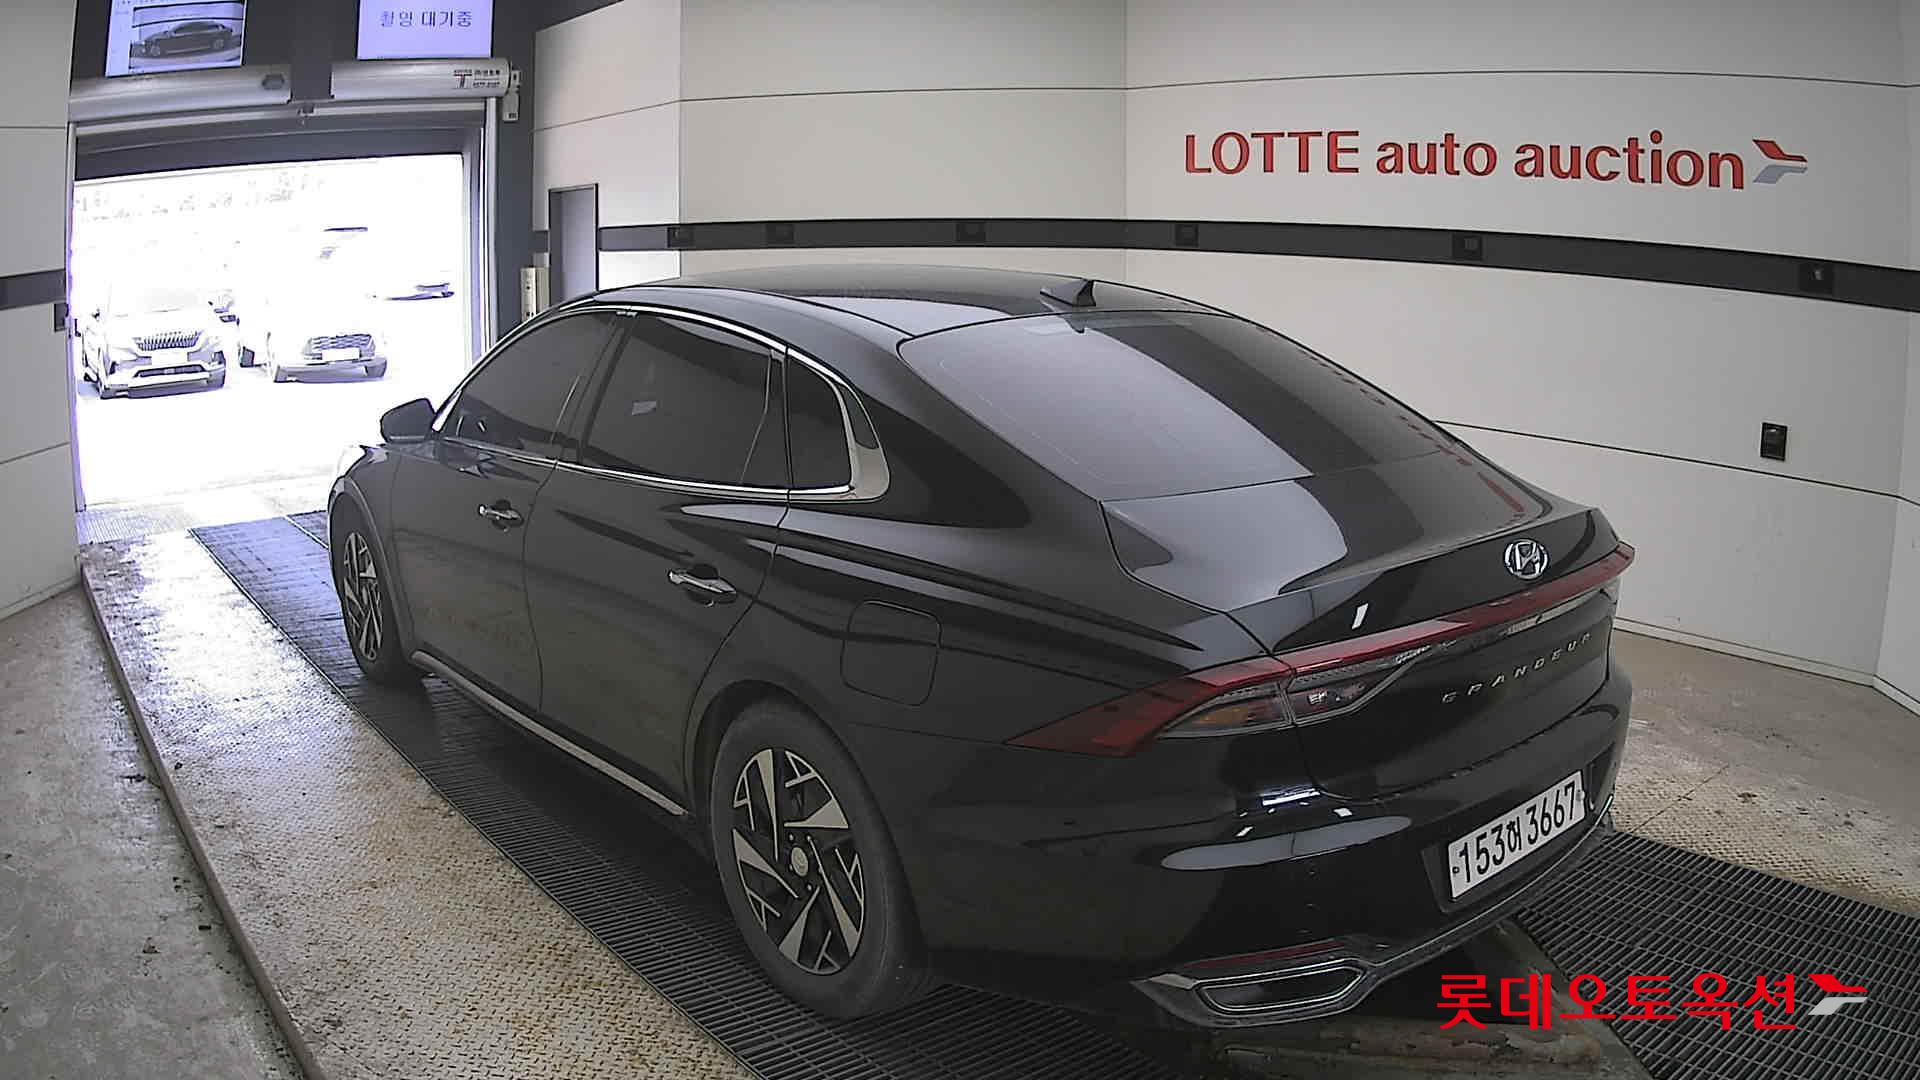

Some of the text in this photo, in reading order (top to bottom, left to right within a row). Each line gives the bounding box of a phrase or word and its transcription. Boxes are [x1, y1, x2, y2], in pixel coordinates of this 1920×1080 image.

[420, 10, 473, 28] 대기중
[1184, 130, 1745, 190] LOTTE auto auction
[1441, 631, 1592, 704] GRANDEUR
[1458, 780, 1576, 883] 153허 3667
